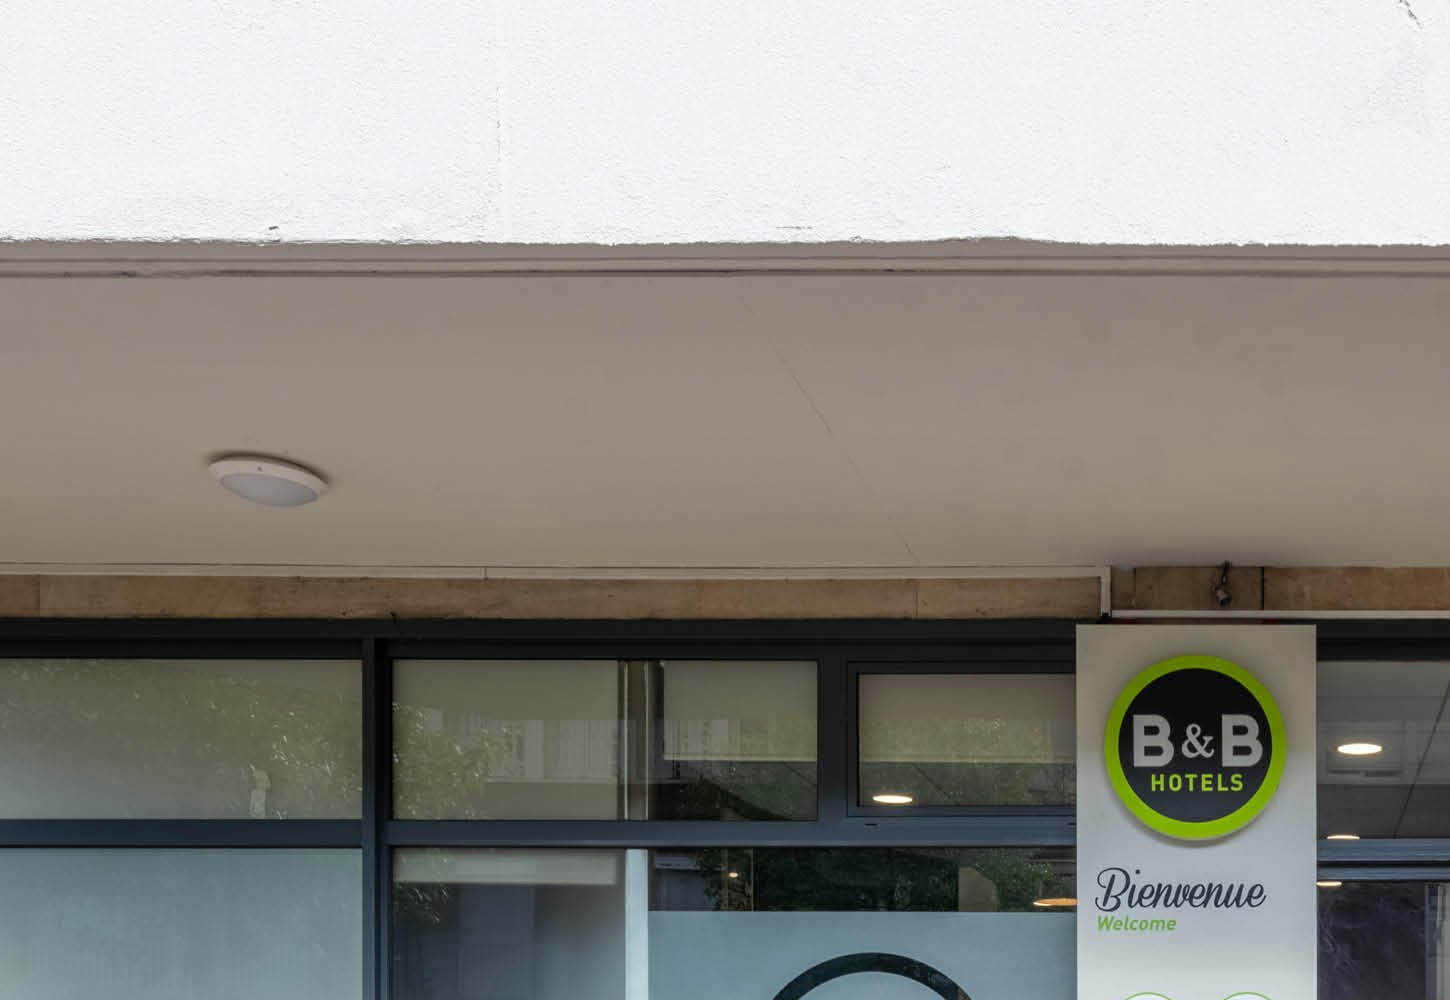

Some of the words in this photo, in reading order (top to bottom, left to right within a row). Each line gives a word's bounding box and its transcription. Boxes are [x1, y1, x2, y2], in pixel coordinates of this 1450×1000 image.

[1133, 714, 1263, 767] B&B
[1151, 773, 1244, 792] HOTELS
[1095, 867, 1267, 912] Bienvenue
[1097, 915, 1177, 931] Welcome
